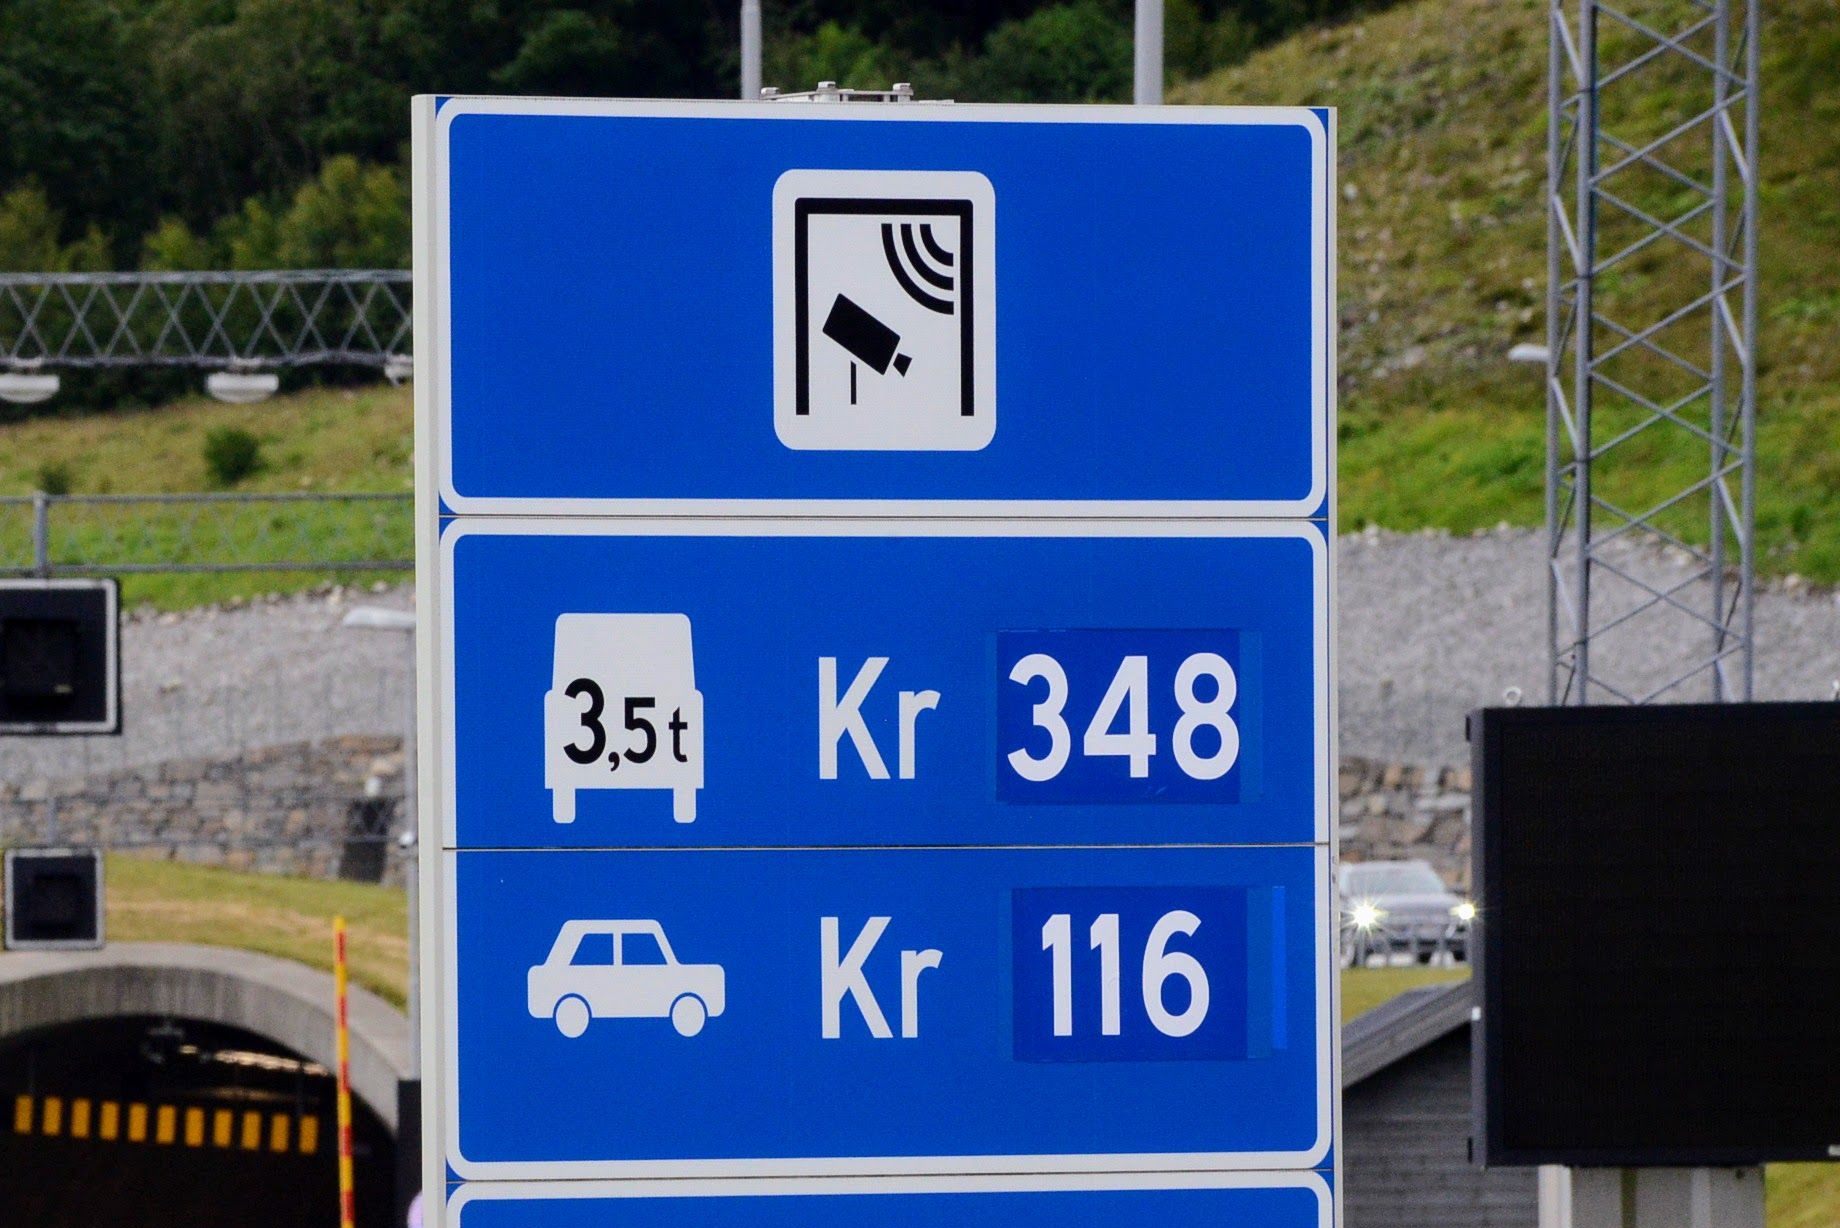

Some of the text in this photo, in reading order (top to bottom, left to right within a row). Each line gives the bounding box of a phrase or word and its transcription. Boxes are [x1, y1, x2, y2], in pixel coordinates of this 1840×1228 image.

[818, 651, 1241, 783] Kr 348
[820, 909, 1211, 1040] Kr 116
